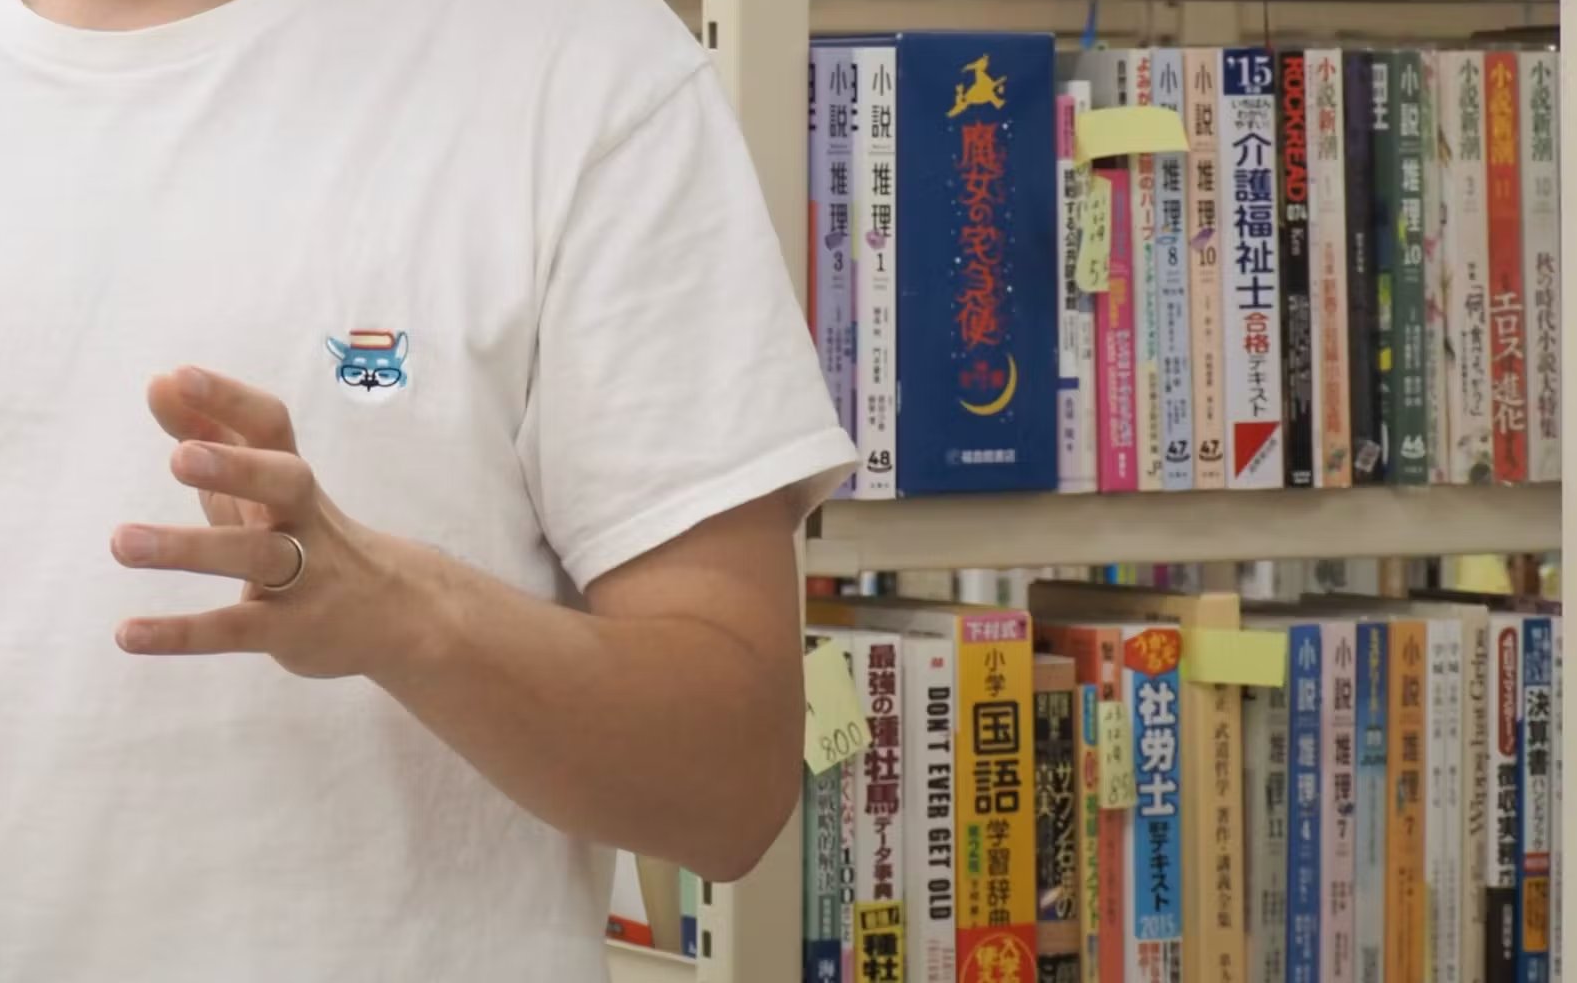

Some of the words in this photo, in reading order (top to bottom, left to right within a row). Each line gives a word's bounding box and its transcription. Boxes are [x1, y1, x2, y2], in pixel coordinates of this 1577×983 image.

[870, 63, 893, 237] 小説推理
[1160, 63, 1182, 232] 小推理
[1459, 58, 1481, 160] 小説新潮
[1490, 58, 1515, 165] 小説新潮
[1530, 58, 1553, 161] 小説新潮
[955, 119, 1002, 350] 魔女の宅急便
[1198, 246, 1216, 267] 10
[1233, 132, 1275, 310] 介護福祉士
[1244, 311, 1271, 417] 合格テキスト
[820, 721, 863, 763] 800
[927, 686, 951, 755] DON'T
[1138, 682, 1178, 816] 社労士
[927, 765, 951, 819] EVER
[928, 827, 952, 868] GET
[928, 875, 952, 921] OLD
